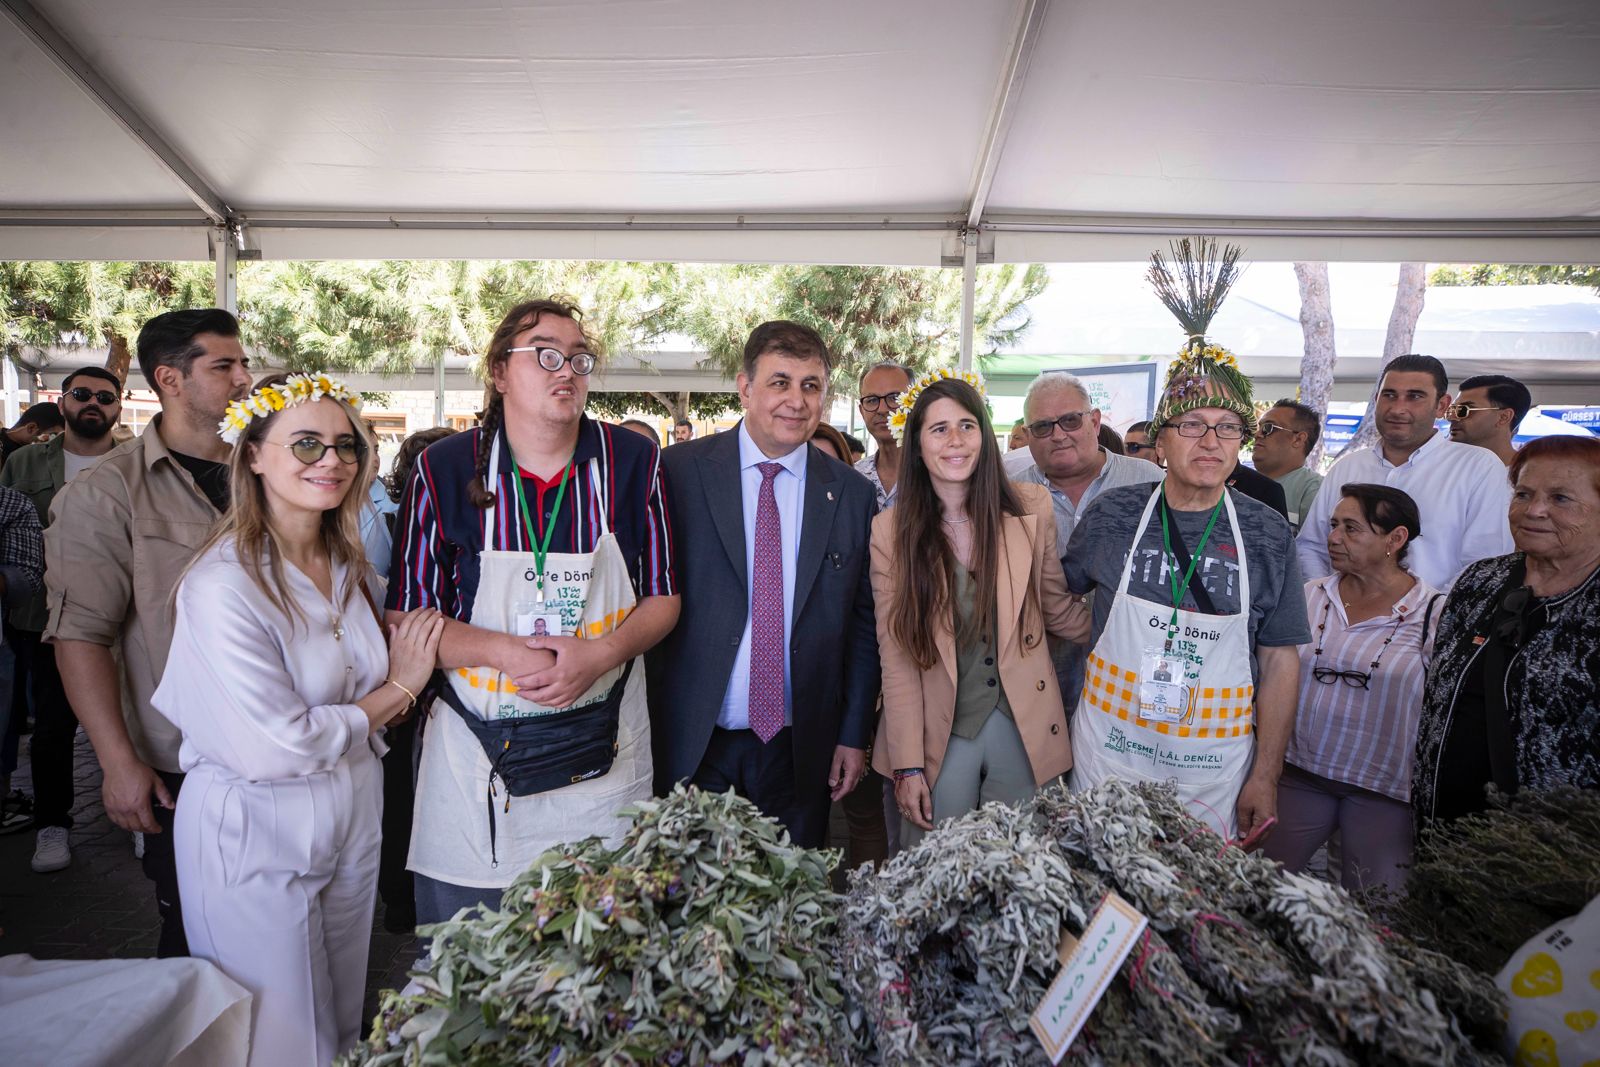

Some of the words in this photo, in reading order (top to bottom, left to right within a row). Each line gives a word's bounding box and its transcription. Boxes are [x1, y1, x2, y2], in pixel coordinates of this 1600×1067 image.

[1184, 626, 1221, 642] Dönüş
[1183, 753, 1223, 763] DENİZLİ
[1084, 920, 1117, 967] ADA
